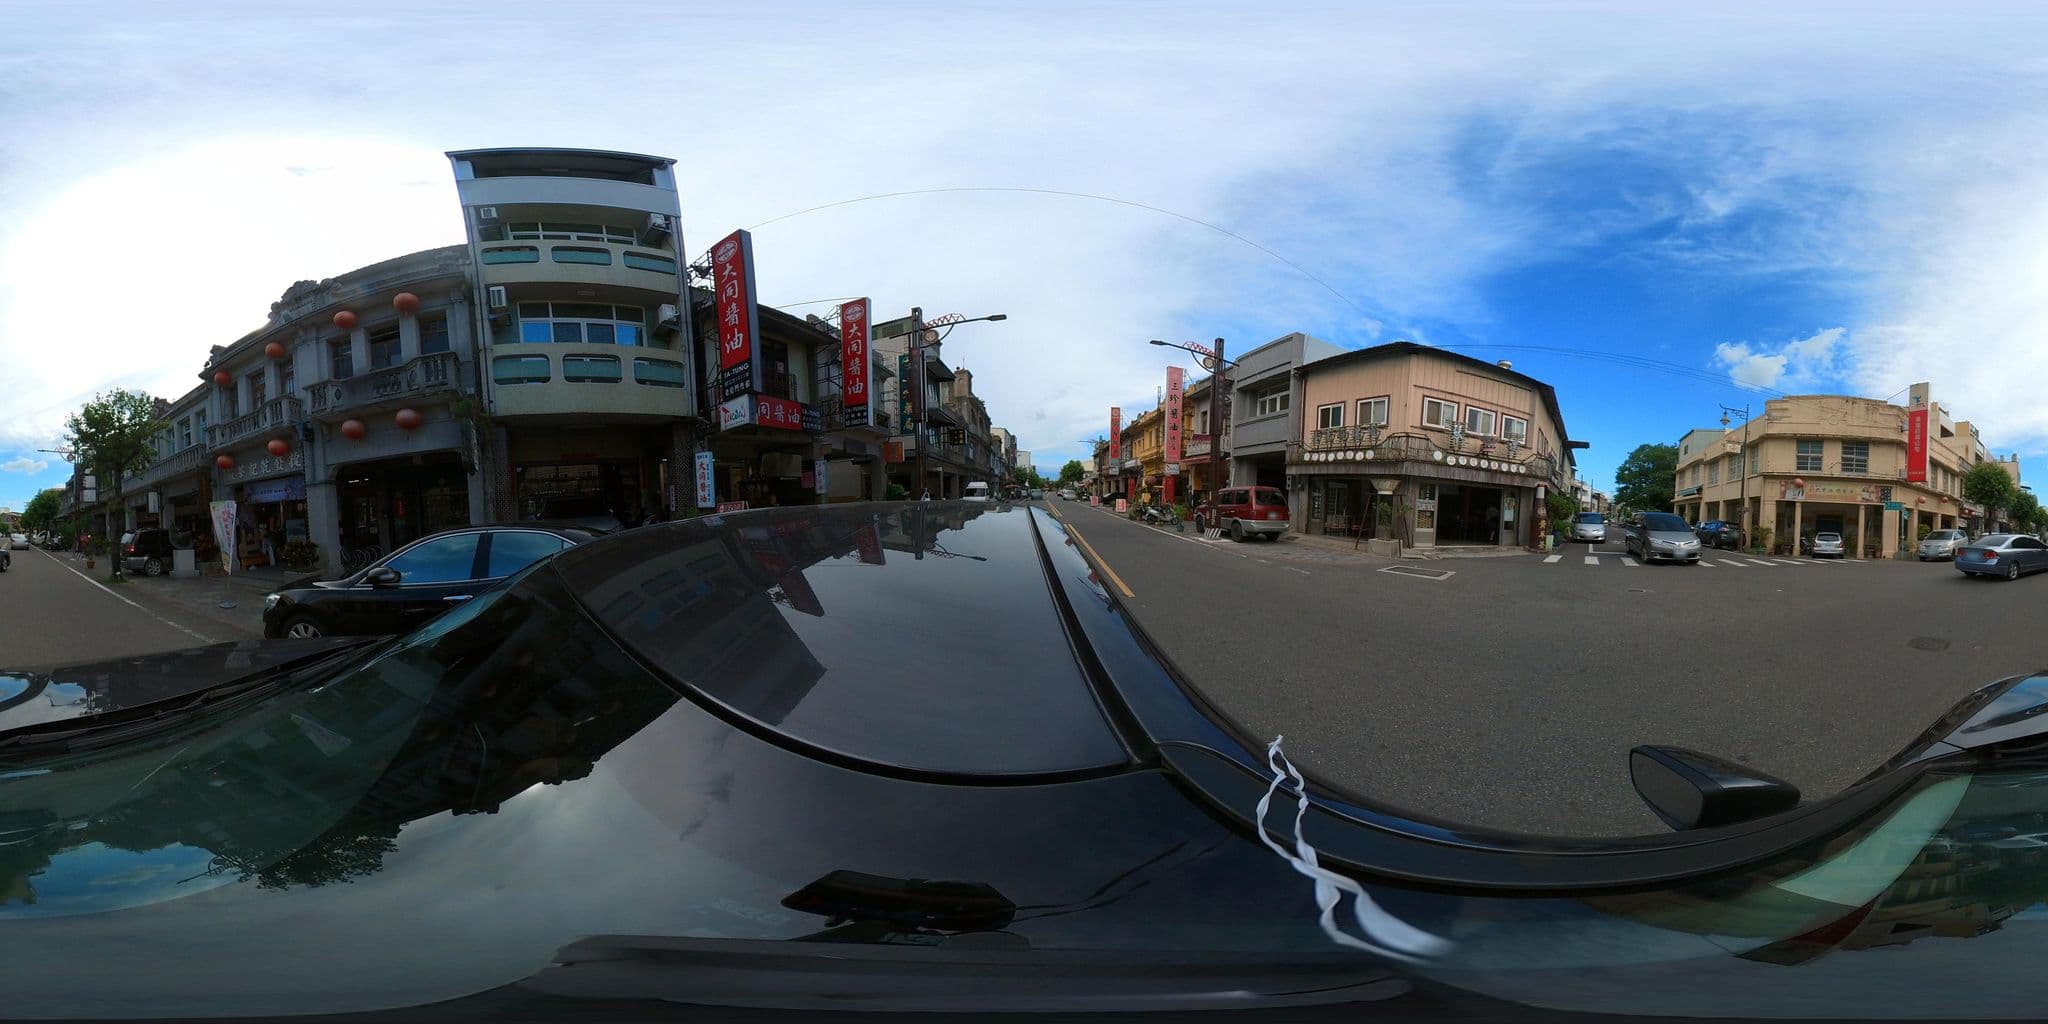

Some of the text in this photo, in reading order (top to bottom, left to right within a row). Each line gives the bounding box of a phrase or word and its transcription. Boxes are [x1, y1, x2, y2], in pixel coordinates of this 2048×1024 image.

[721, 262, 744, 354] 大同醬油
[847, 322, 864, 395] 大同醬油
[1169, 382, 1180, 431] 三珍醬油
